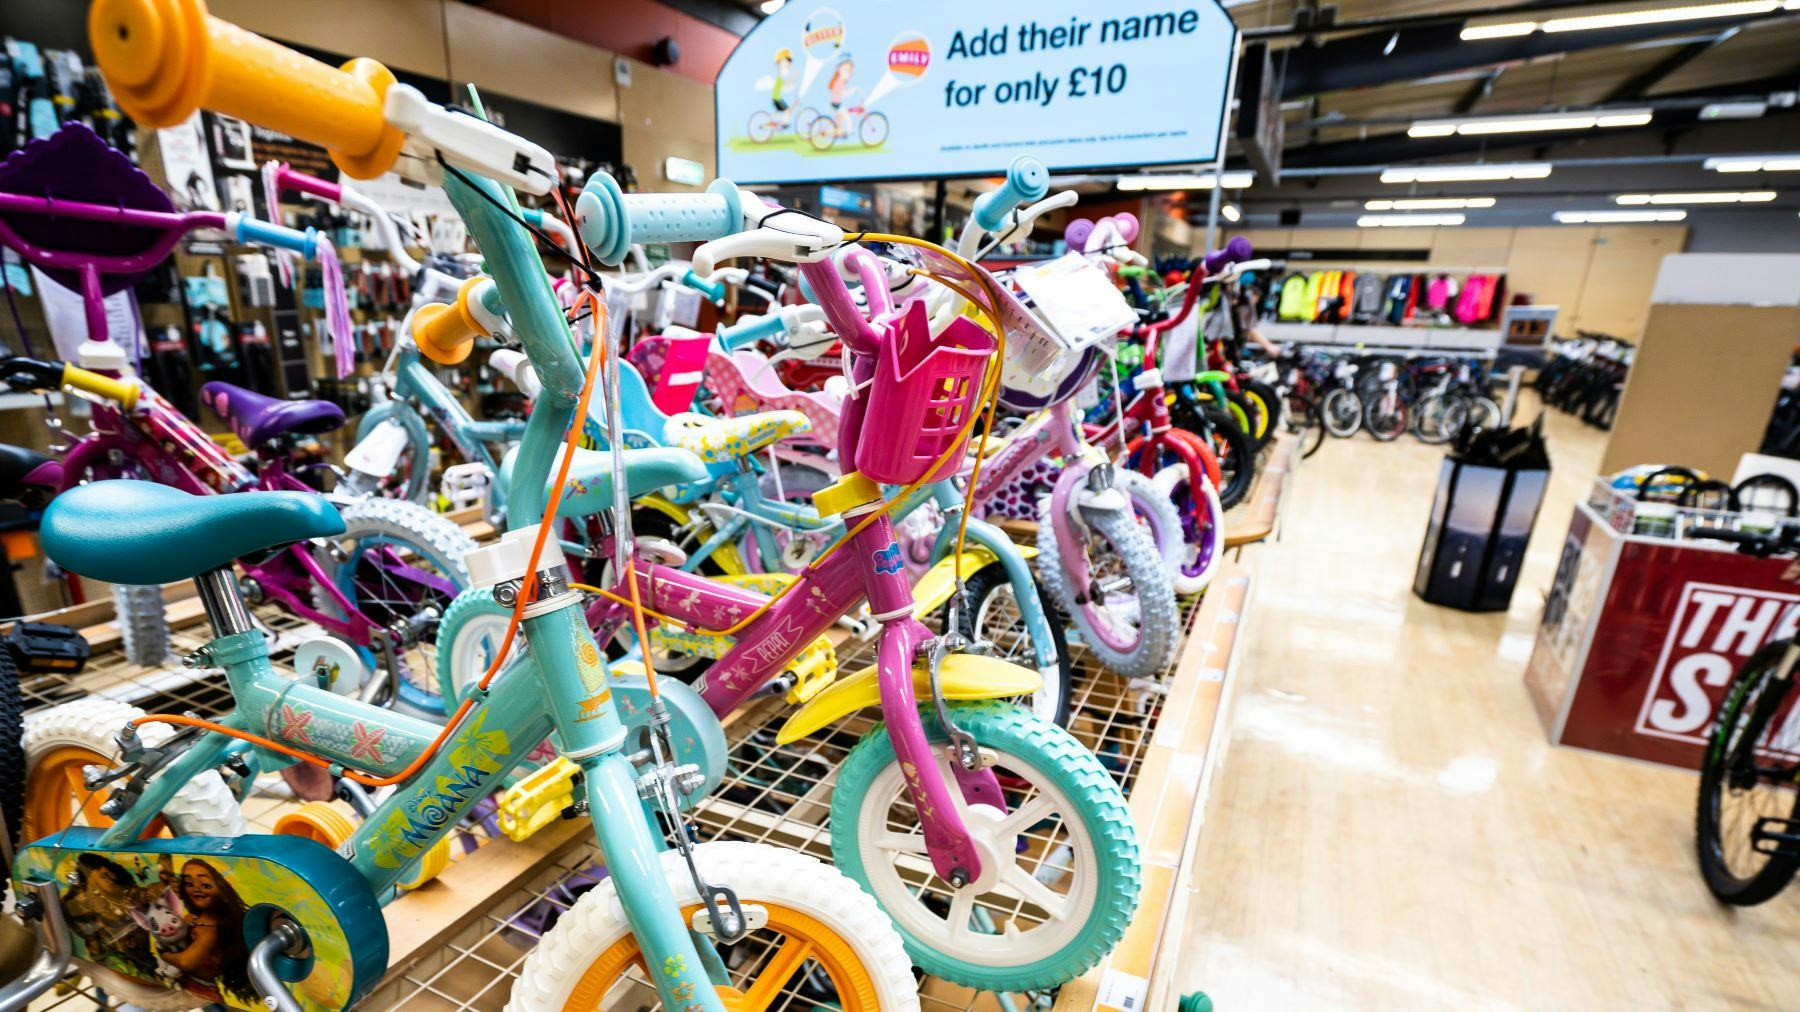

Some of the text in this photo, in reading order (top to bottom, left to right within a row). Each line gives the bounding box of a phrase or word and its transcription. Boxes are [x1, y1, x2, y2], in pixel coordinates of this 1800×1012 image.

[946, 9, 1199, 60] Add their name
[889, 51, 929, 67] EMILY
[944, 63, 1128, 107] for only £10
[756, 631, 790, 663] PEPPA
[401, 765, 490, 849] MOANA
